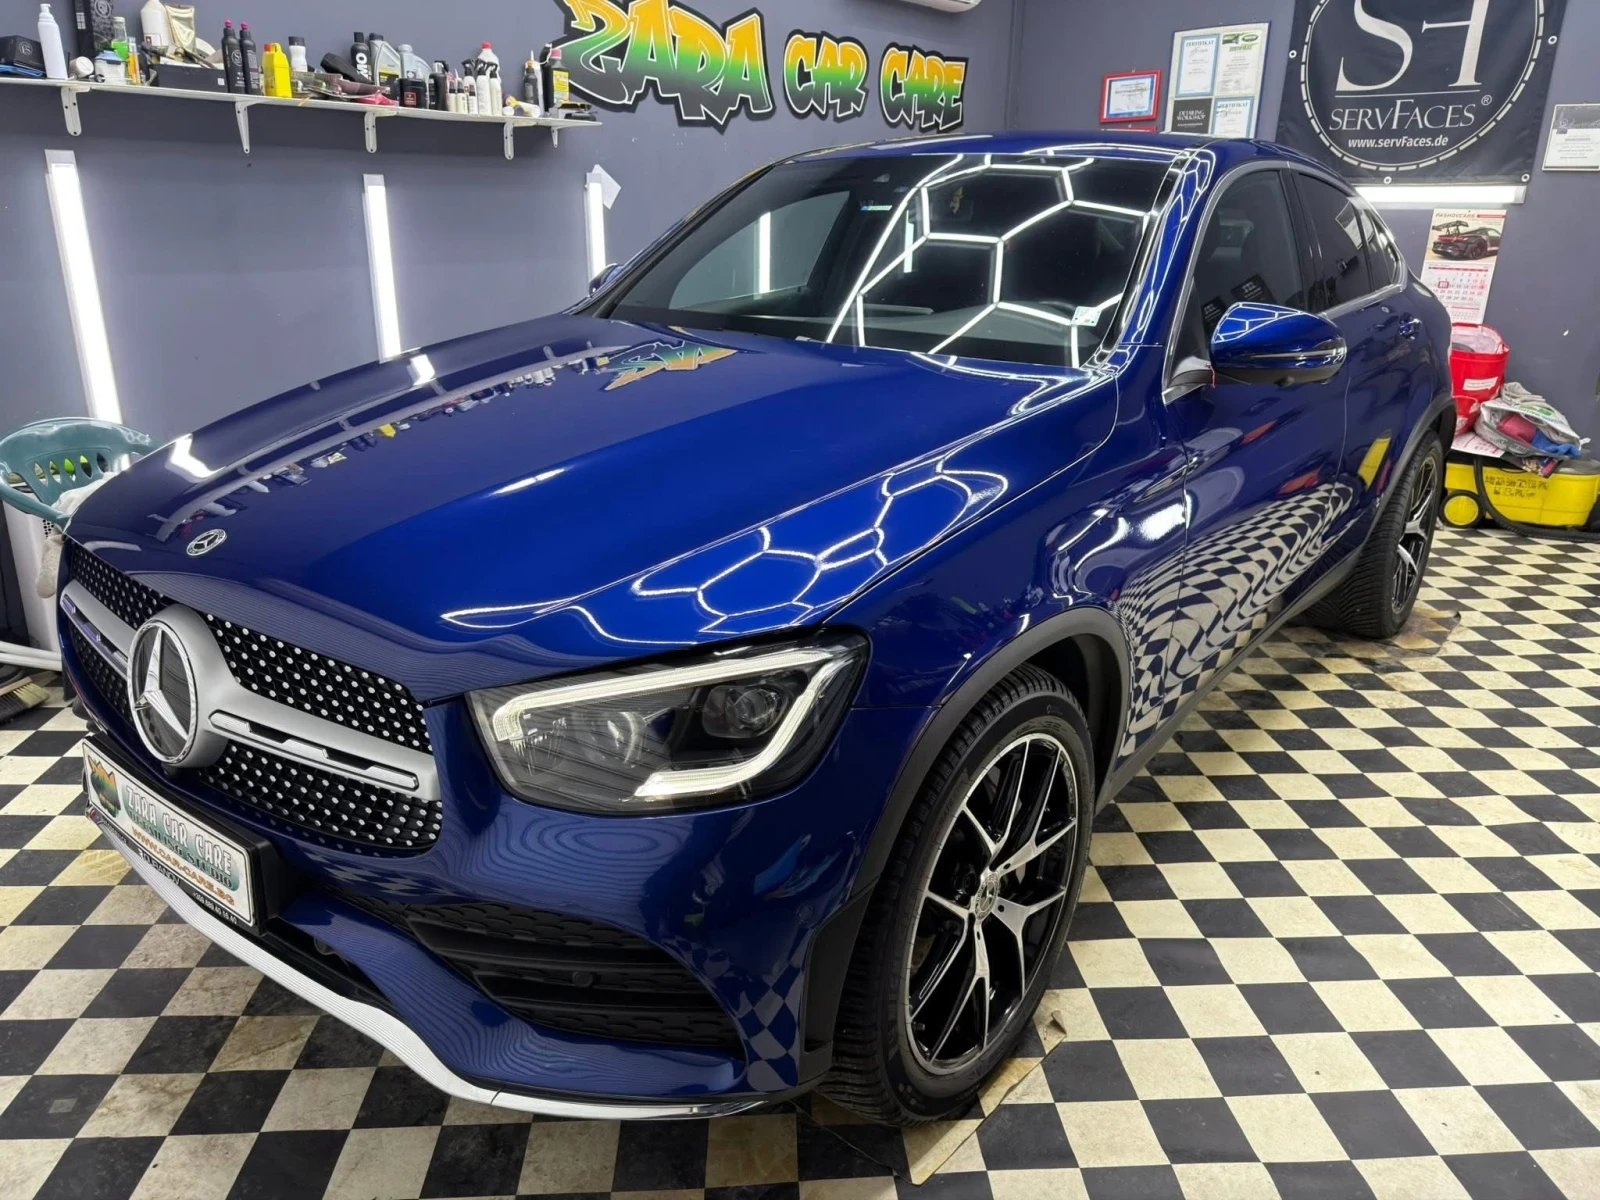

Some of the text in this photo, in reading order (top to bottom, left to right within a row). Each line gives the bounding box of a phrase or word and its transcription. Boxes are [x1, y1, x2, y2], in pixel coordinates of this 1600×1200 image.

[557, 0, 772, 124] ZARA
[783, 34, 867, 118] CAR
[880, 47, 966, 130] CARE
[1348, 135, 1449, 149] www.servFaces.de
[126, 785, 157, 827] ZARA
[162, 812, 188, 849] CAR
[194, 833, 232, 876] CARE
[187, 853, 233, 888] STUDIO
